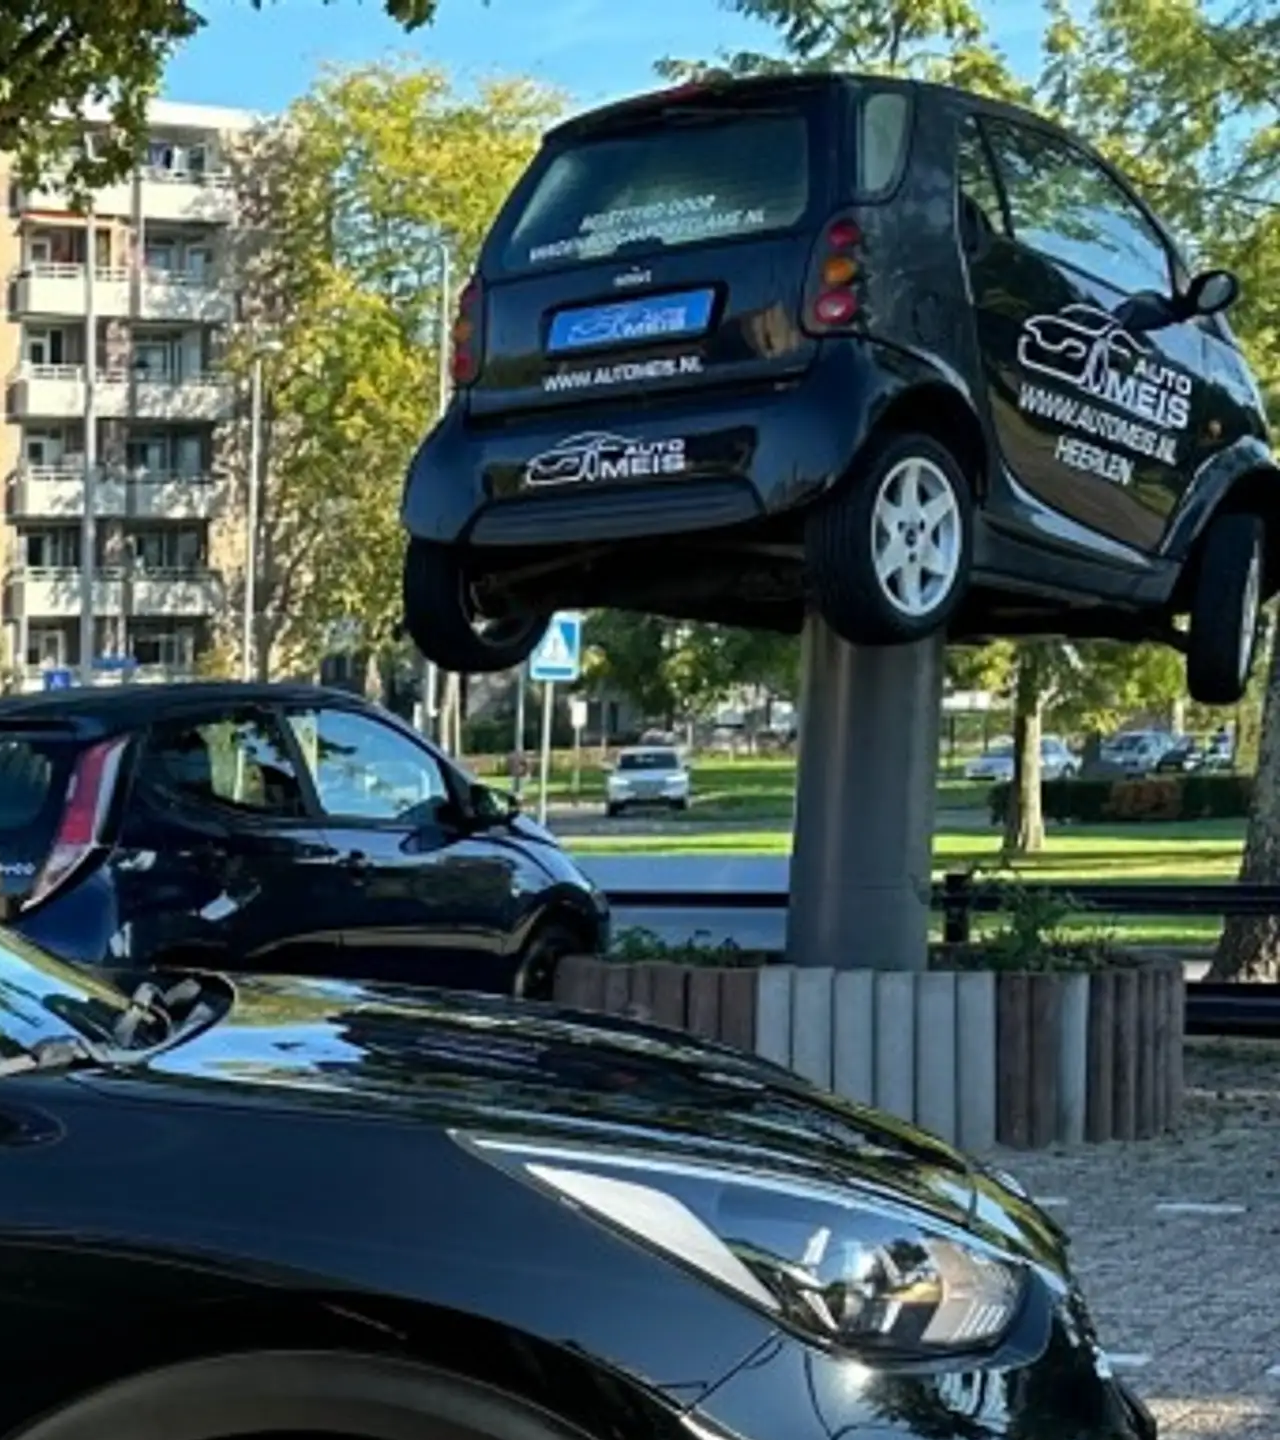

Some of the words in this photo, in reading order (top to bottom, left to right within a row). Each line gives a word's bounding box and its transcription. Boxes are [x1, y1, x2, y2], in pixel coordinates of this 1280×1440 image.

[543, 355, 704, 393] WWW.AUTOMEIS.NL
[1134, 357, 1193, 396] AUTO
[1105, 368, 1192, 430] MEIS
[1017, 380, 1178, 467] WWW.AUTOMEIS.NL
[624, 437, 687, 456] AUTO
[1053, 433, 1135, 487] HEERLEN
[600, 453, 687, 480] MEIS
